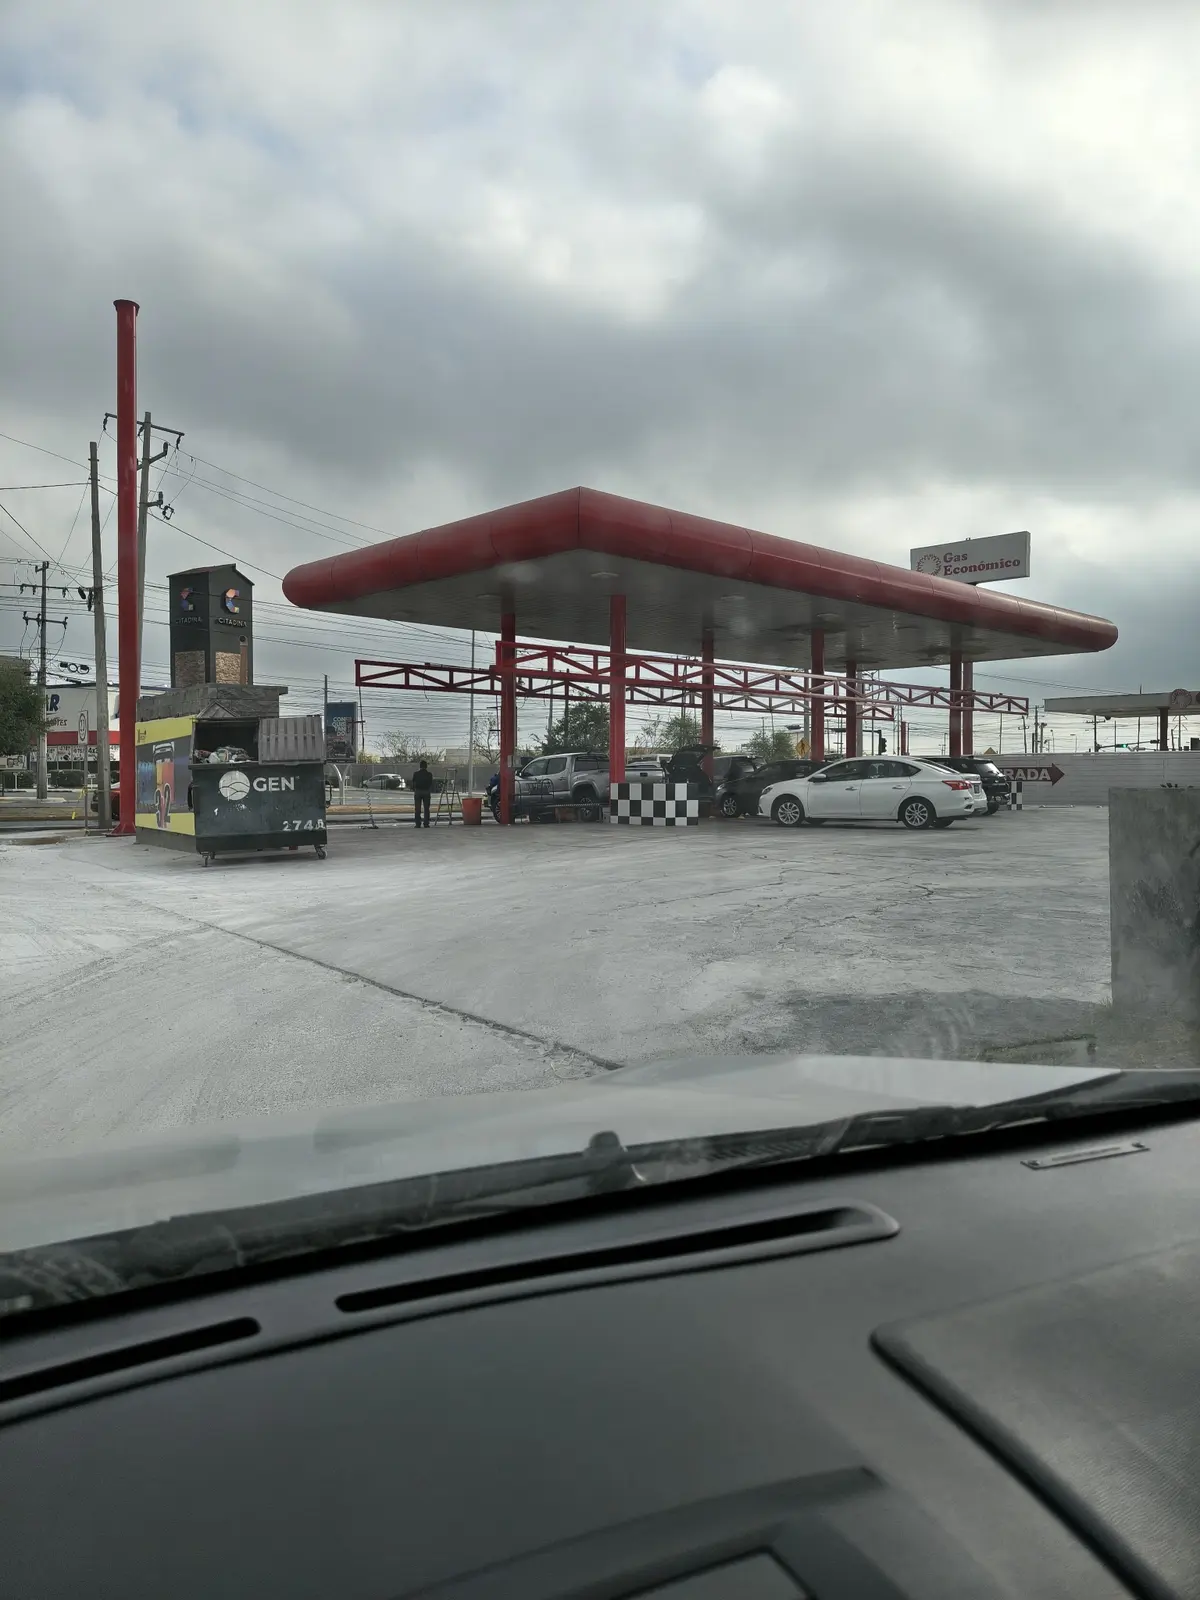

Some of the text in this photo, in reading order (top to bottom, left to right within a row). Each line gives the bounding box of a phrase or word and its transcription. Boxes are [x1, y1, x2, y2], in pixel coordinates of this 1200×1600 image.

[943, 552, 968, 564] Gas
[943, 557, 1021, 577] Económico
[218, 617, 248, 628] CITADINA
[1000, 768, 1051, 781] RADA
[252, 776, 295, 792] GEN
